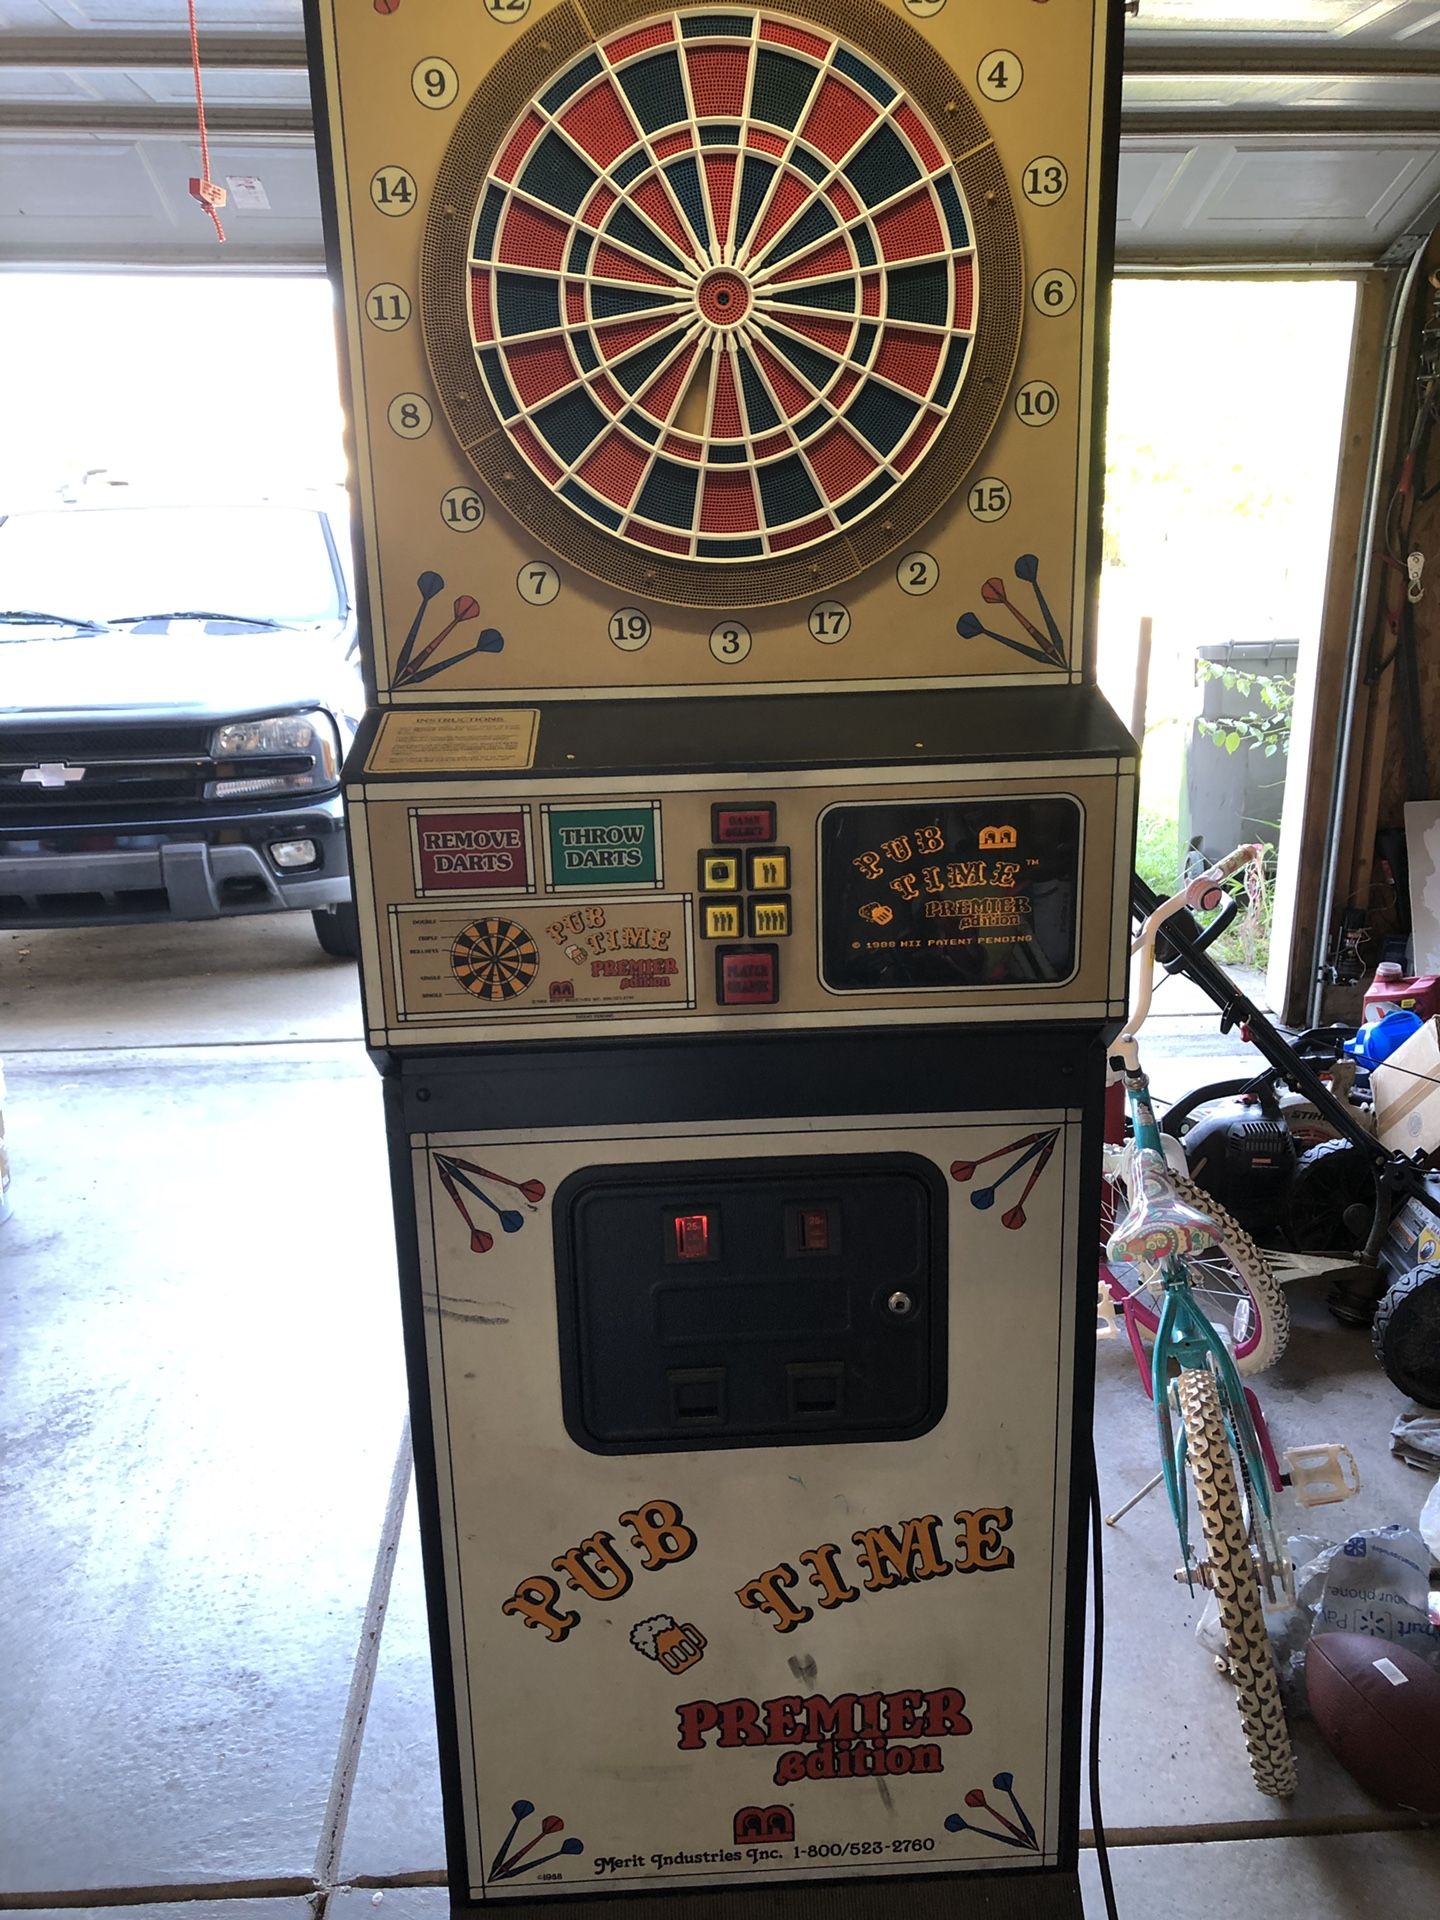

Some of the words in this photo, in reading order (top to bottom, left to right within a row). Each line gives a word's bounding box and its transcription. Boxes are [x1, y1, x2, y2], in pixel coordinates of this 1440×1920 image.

[424, 69, 447, 98] 9
[987, 61, 1008, 89] 4
[375, 176, 412, 204] 14
[1027, 167, 1063, 195] 13
[1043, 280, 1063, 306] 6
[373, 294, 406, 322] 11
[400, 403, 420, 429] 8
[1021, 390, 1054, 416] 10
[445, 496, 481, 523] 16
[973, 487, 1006, 512] 15
[529, 571, 548, 595] 7
[909, 562, 927, 586] 2
[613, 616, 647, 640] 19
[814, 611, 845, 635] 17
[721, 630, 741, 655] 3
[424, 830, 520, 850] REMOVE
[561, 826, 644, 846] THROW
[435, 853, 513, 873] DARTS
[566, 850, 642, 870] DARTS
[852, 825, 945, 880] PUB
[889, 860, 1021, 901] TIME
[925, 895, 1032, 918] PREMIER
[546, 906, 606, 945] PUB
[586, 926, 671, 956] TIME
[927, 937, 972, 946] PATENT
[977, 934, 1033, 944] PENDING
[591, 957, 679, 978] PREMIER
[1291, 1110, 1327, 1121] STIH
[502, 1499, 698, 1643] PUB
[735, 1506, 1015, 1634] TIME
[675, 1687, 973, 1751] PREMIER
[773, 1738, 945, 1786] edition
[594, 1854, 645, 1875] Merit
[650, 1848, 742, 1870] Industries
[748, 1846, 784, 1866] Inc.
[794, 1837, 936, 1860] 1-800/523-2760
